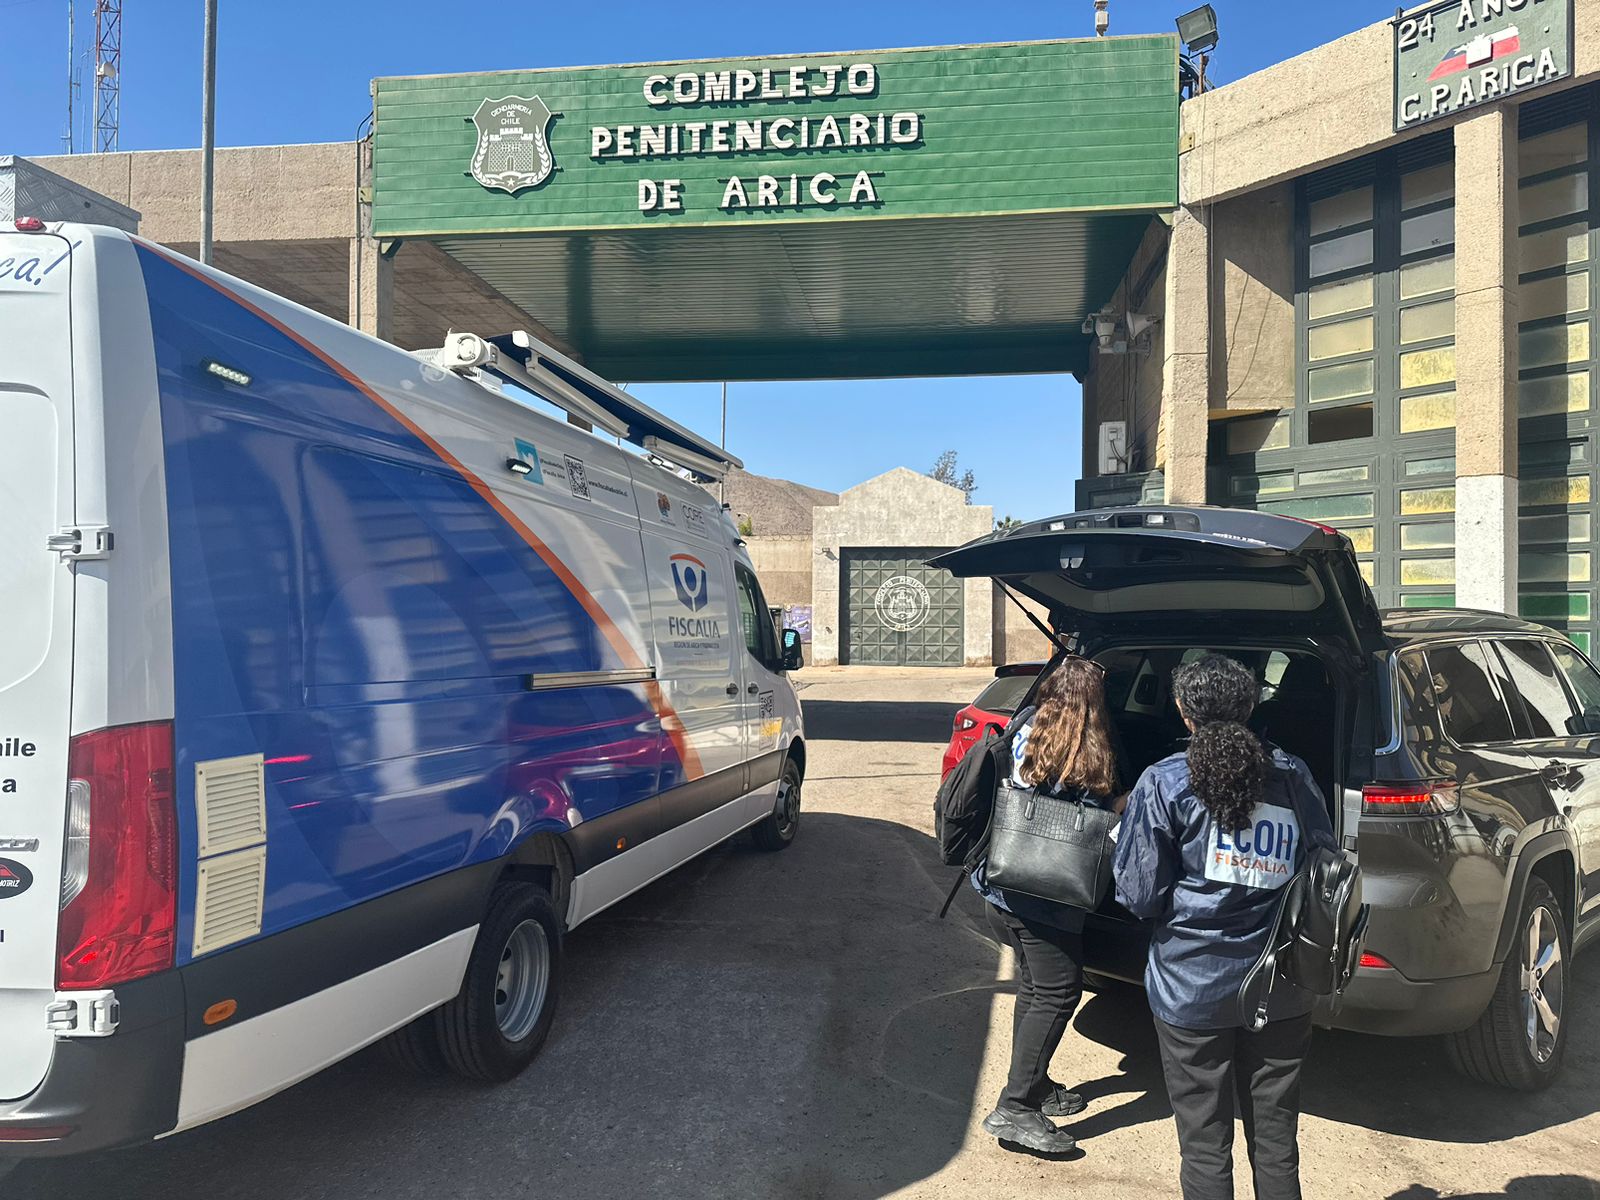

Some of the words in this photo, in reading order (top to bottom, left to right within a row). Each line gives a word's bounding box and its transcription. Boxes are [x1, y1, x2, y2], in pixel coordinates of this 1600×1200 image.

[1398, 12, 1434, 48] 24
[643, 63, 876, 105] COMPLEJO
[500, 117, 520, 125] CHILE
[592, 112, 919, 157] PENITENCIARIO
[638, 179, 681, 210] DE
[721, 170, 877, 208] ARICA
[668, 615, 721, 639] FISCALIA
[0, 738, 36, 757] ile
[1215, 852, 1288, 875] FISCALIA
